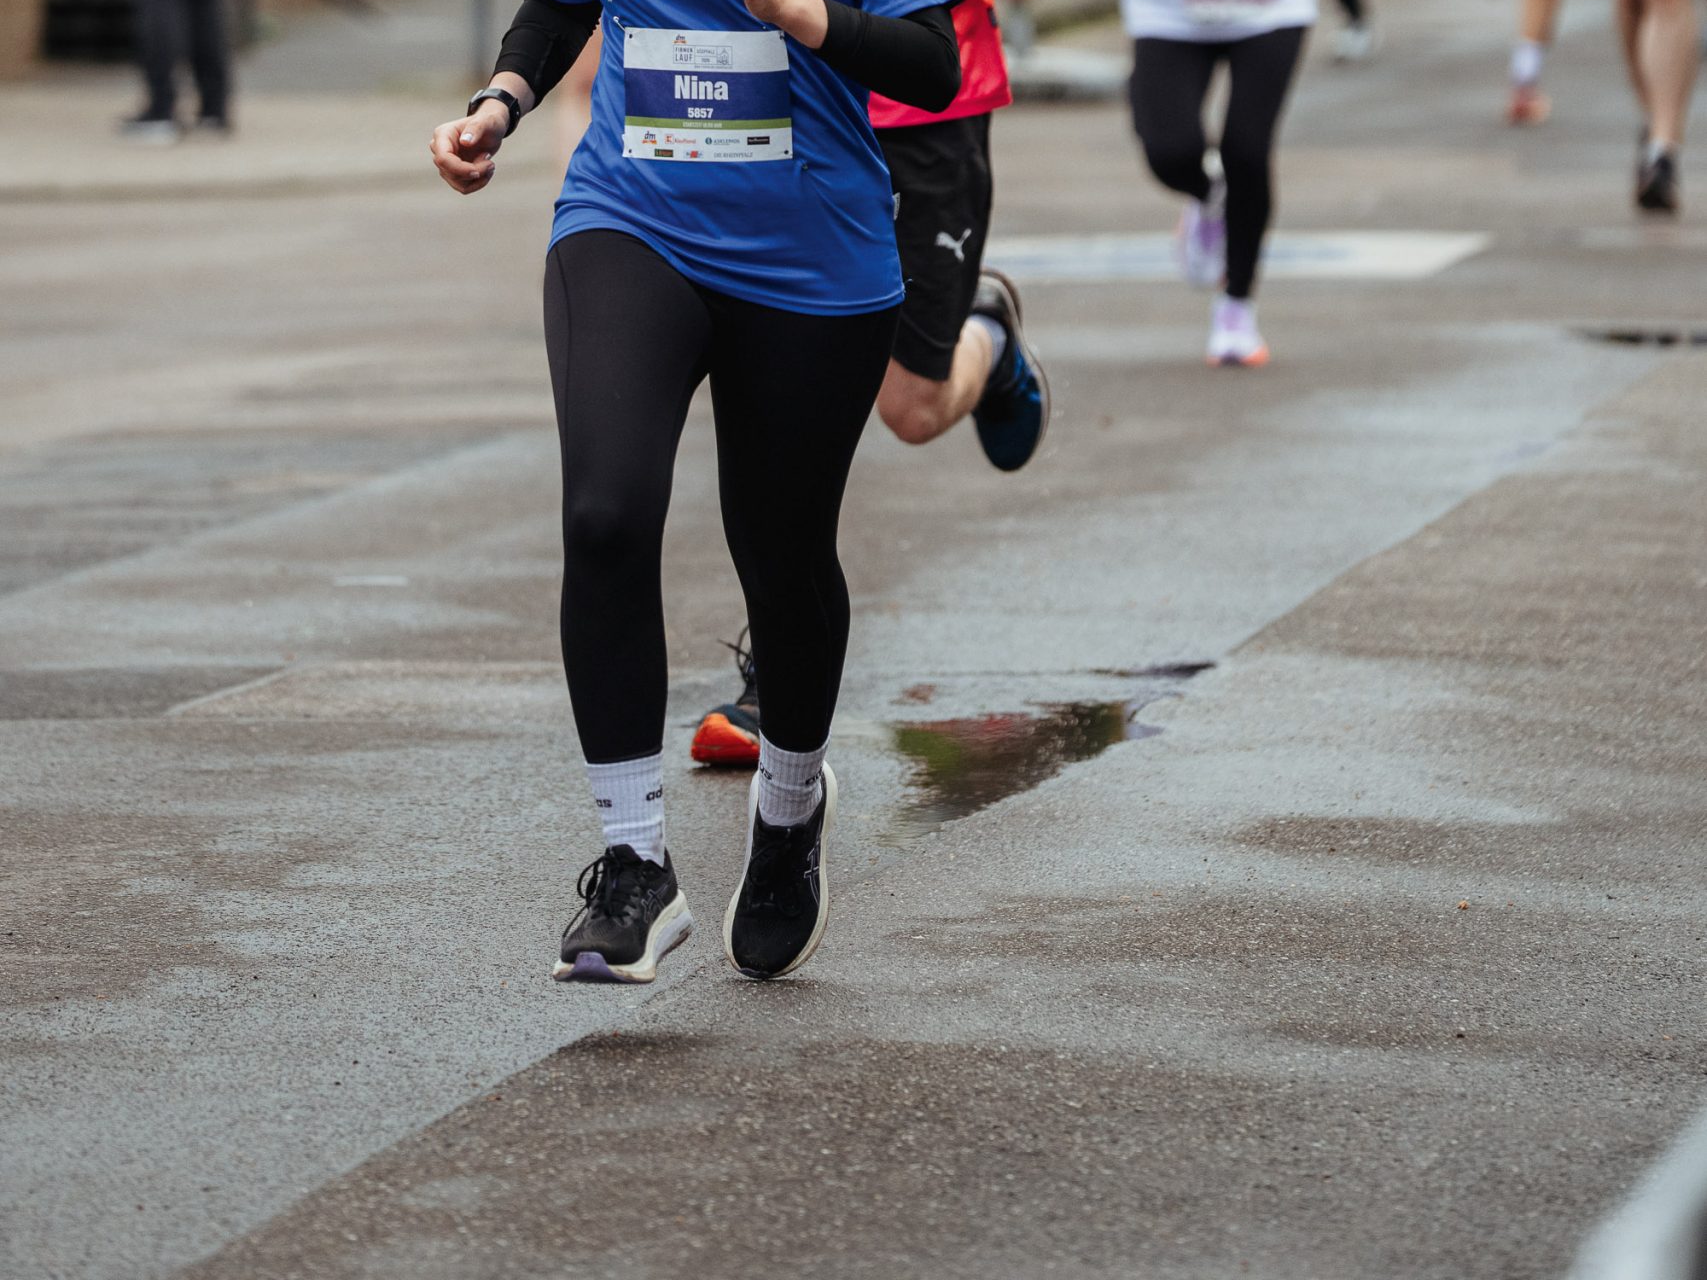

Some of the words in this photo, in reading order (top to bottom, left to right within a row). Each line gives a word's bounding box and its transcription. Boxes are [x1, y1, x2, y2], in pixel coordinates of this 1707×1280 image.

[675, 54, 693, 62] LAUF
[674, 74, 729, 101] Nina
[687, 107, 714, 119] 5857
[644, 130, 656, 140] dm
